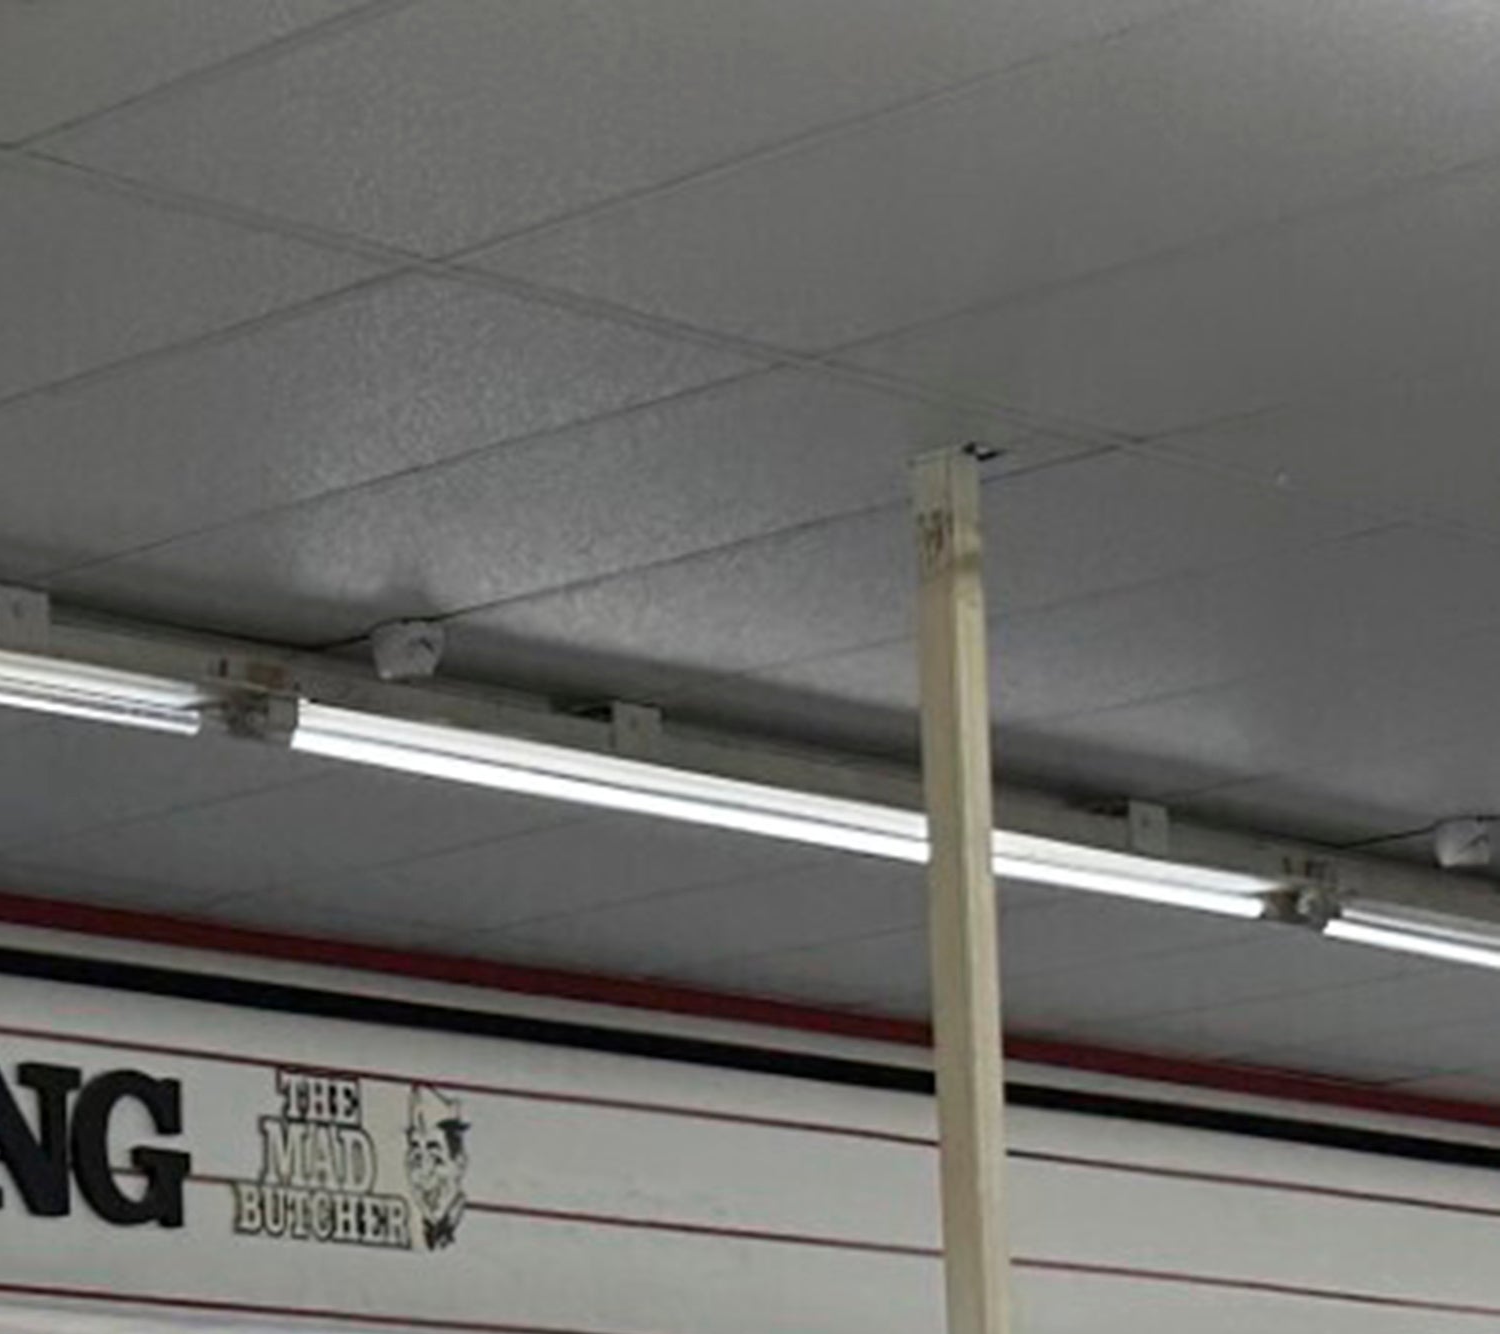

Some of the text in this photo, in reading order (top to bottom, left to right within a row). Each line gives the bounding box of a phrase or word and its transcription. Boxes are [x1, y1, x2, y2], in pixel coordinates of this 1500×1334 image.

[278, 1067, 361, 1128] THE
[259, 1118, 375, 1197] MAD
[231, 1180, 412, 1250] BUTCHER
